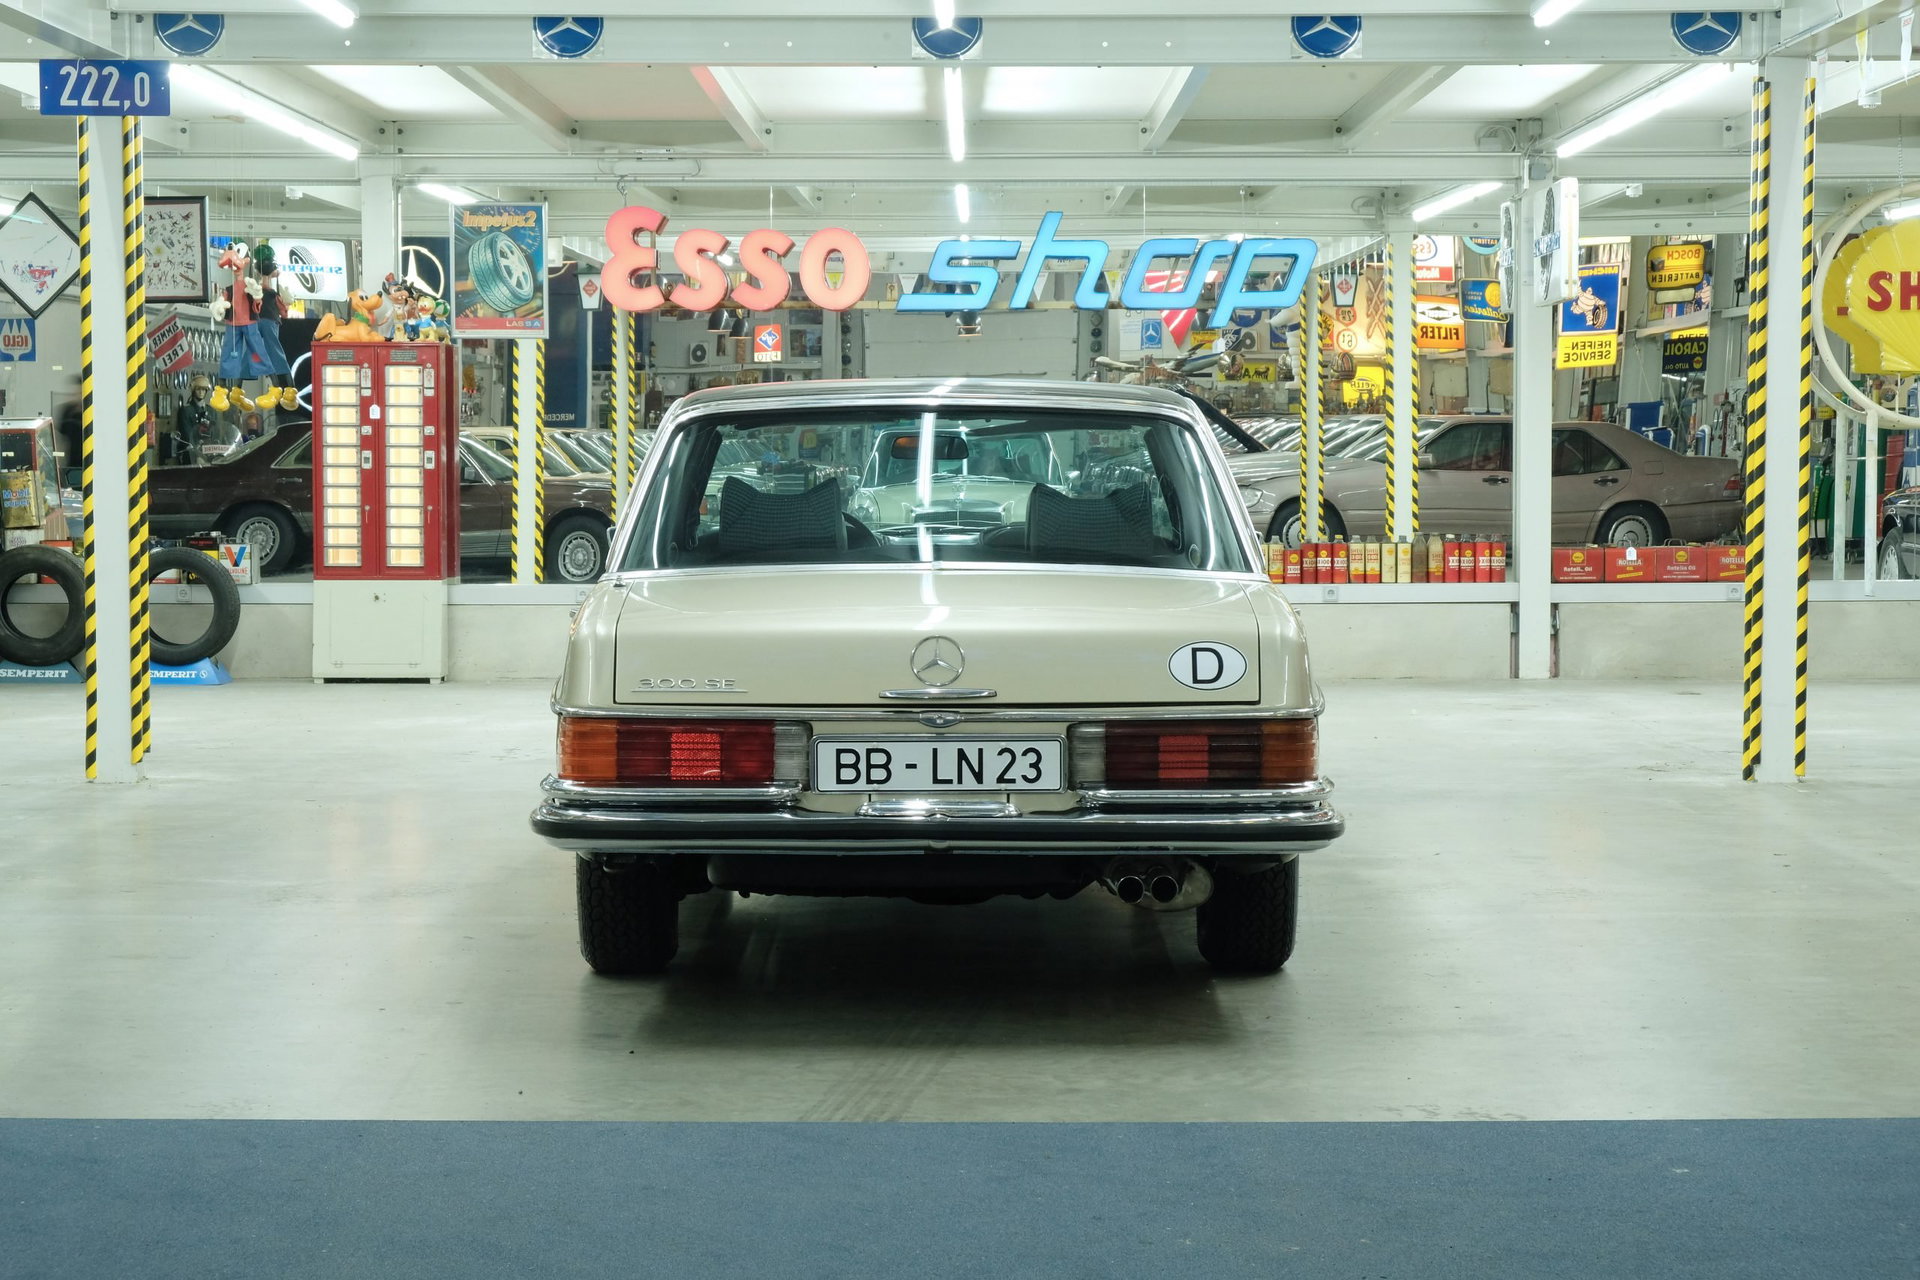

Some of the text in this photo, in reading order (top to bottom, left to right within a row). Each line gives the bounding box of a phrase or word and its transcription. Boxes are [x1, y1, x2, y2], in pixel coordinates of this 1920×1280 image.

[59, 66, 150, 111] 222,0
[897, 211, 1318, 329] shop
[3, 488, 30, 499] Mobil
[0, 668, 69, 678] SEMPERIT
[149, 669, 197, 678] EMPERIT
[1192, 647, 1223, 684] D
[638, 678, 736, 689] 300 SE
[835, 747, 892, 785] BB
[997, 747, 1042, 784] 23
